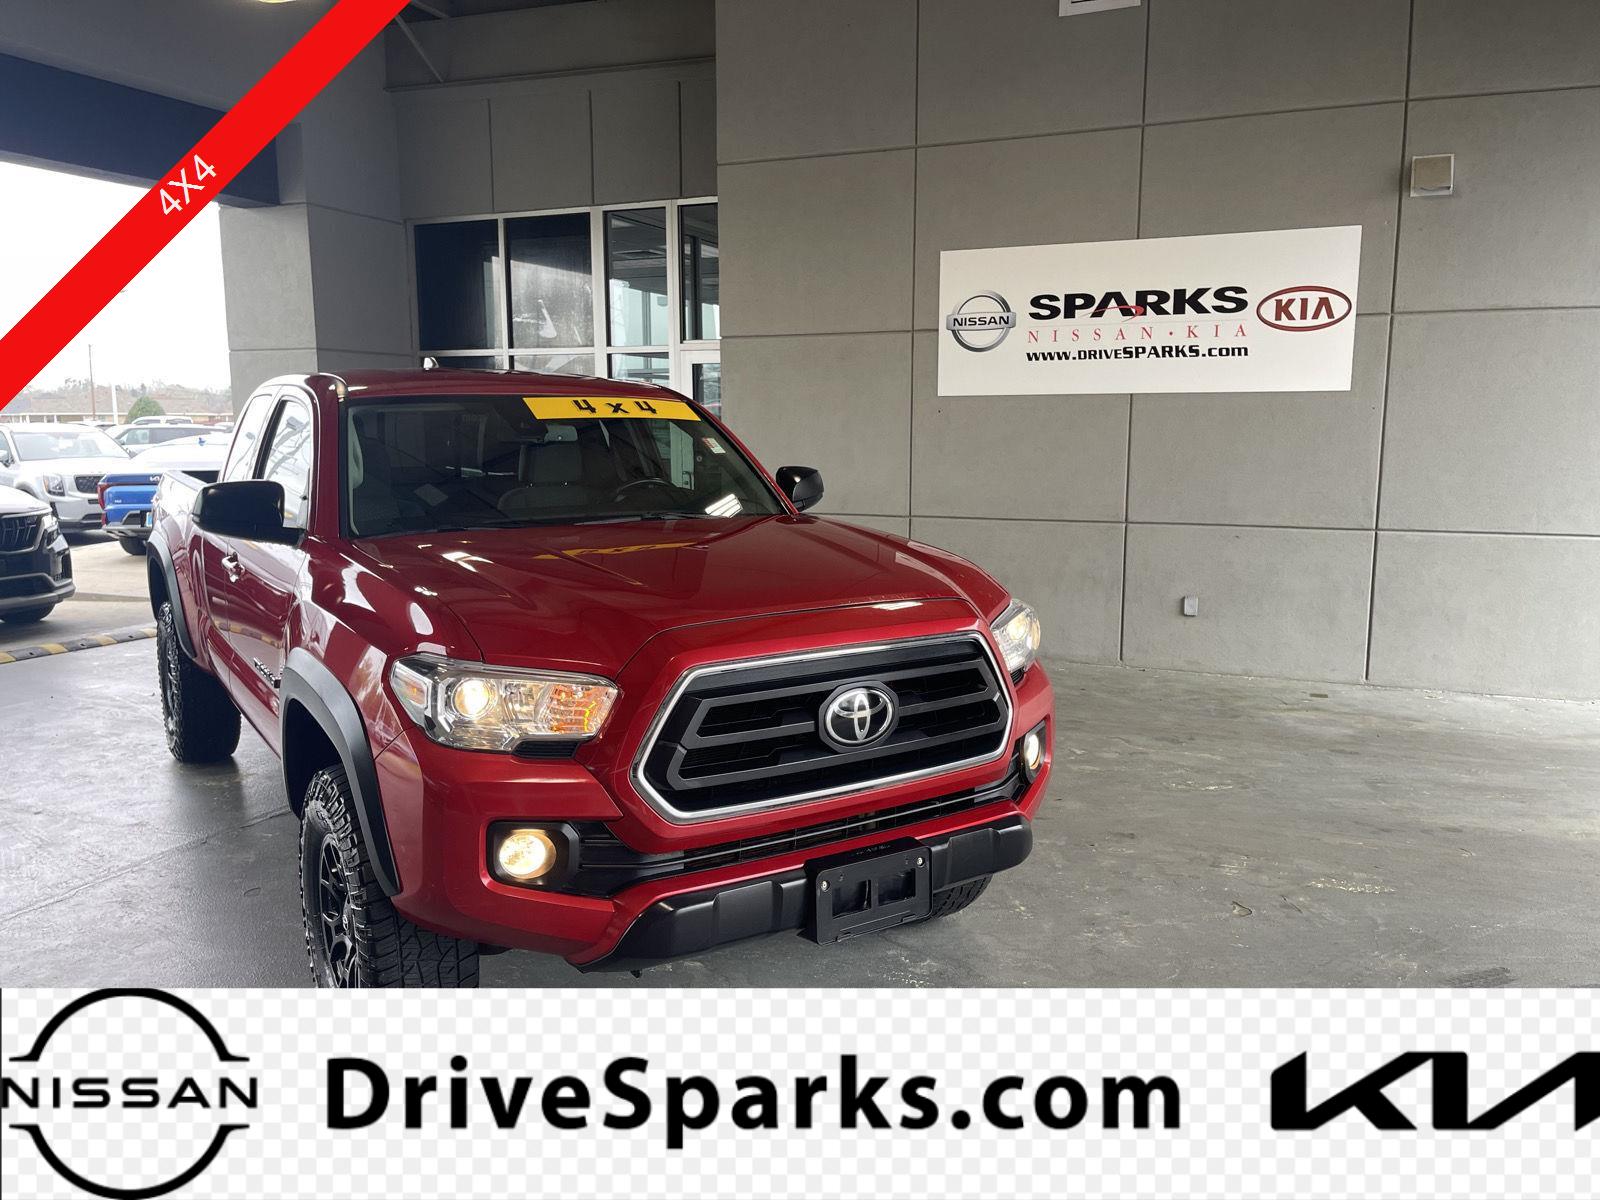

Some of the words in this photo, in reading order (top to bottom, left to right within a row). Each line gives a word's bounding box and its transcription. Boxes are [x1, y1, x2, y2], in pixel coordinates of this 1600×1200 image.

[1028, 286, 1249, 321] SPARKS
[1274, 297, 1336, 322] KIA
[952, 315, 1011, 328] NISSAN
[1027, 327, 1154, 343] NISSAN
[1187, 323, 1247, 339] KIA
